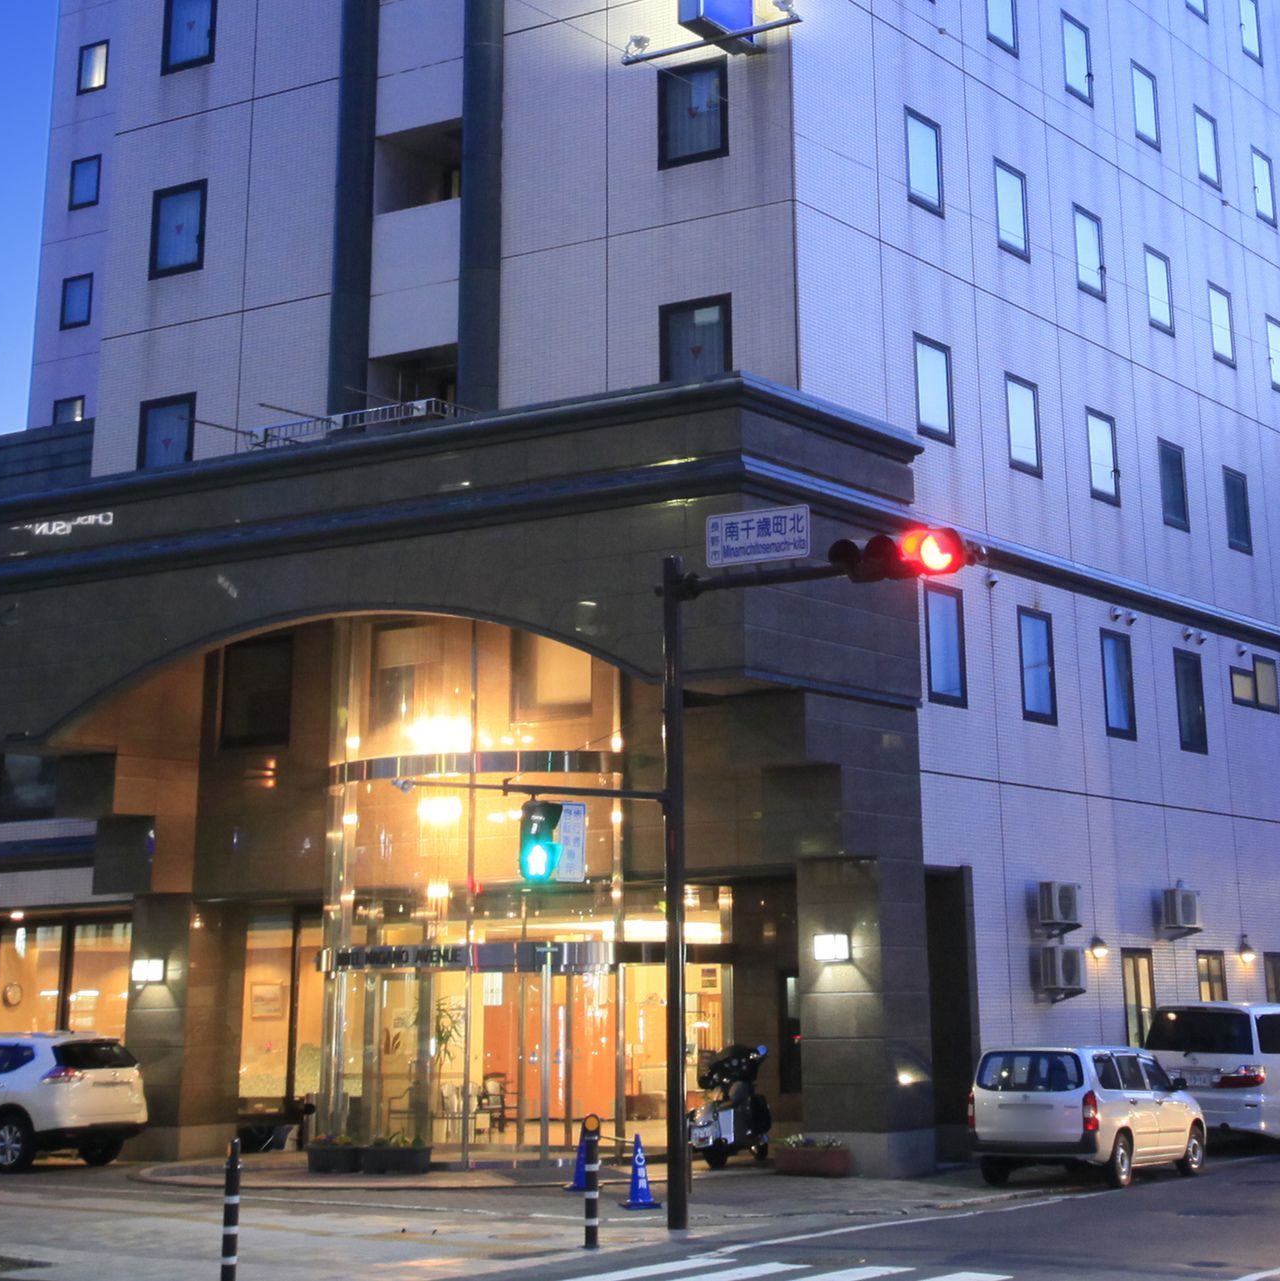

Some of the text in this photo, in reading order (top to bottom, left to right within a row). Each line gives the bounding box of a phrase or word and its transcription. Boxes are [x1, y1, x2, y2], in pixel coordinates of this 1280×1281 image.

[724, 513, 805, 542] 南千歳町北
[415, 948, 462, 963] AVENUE
